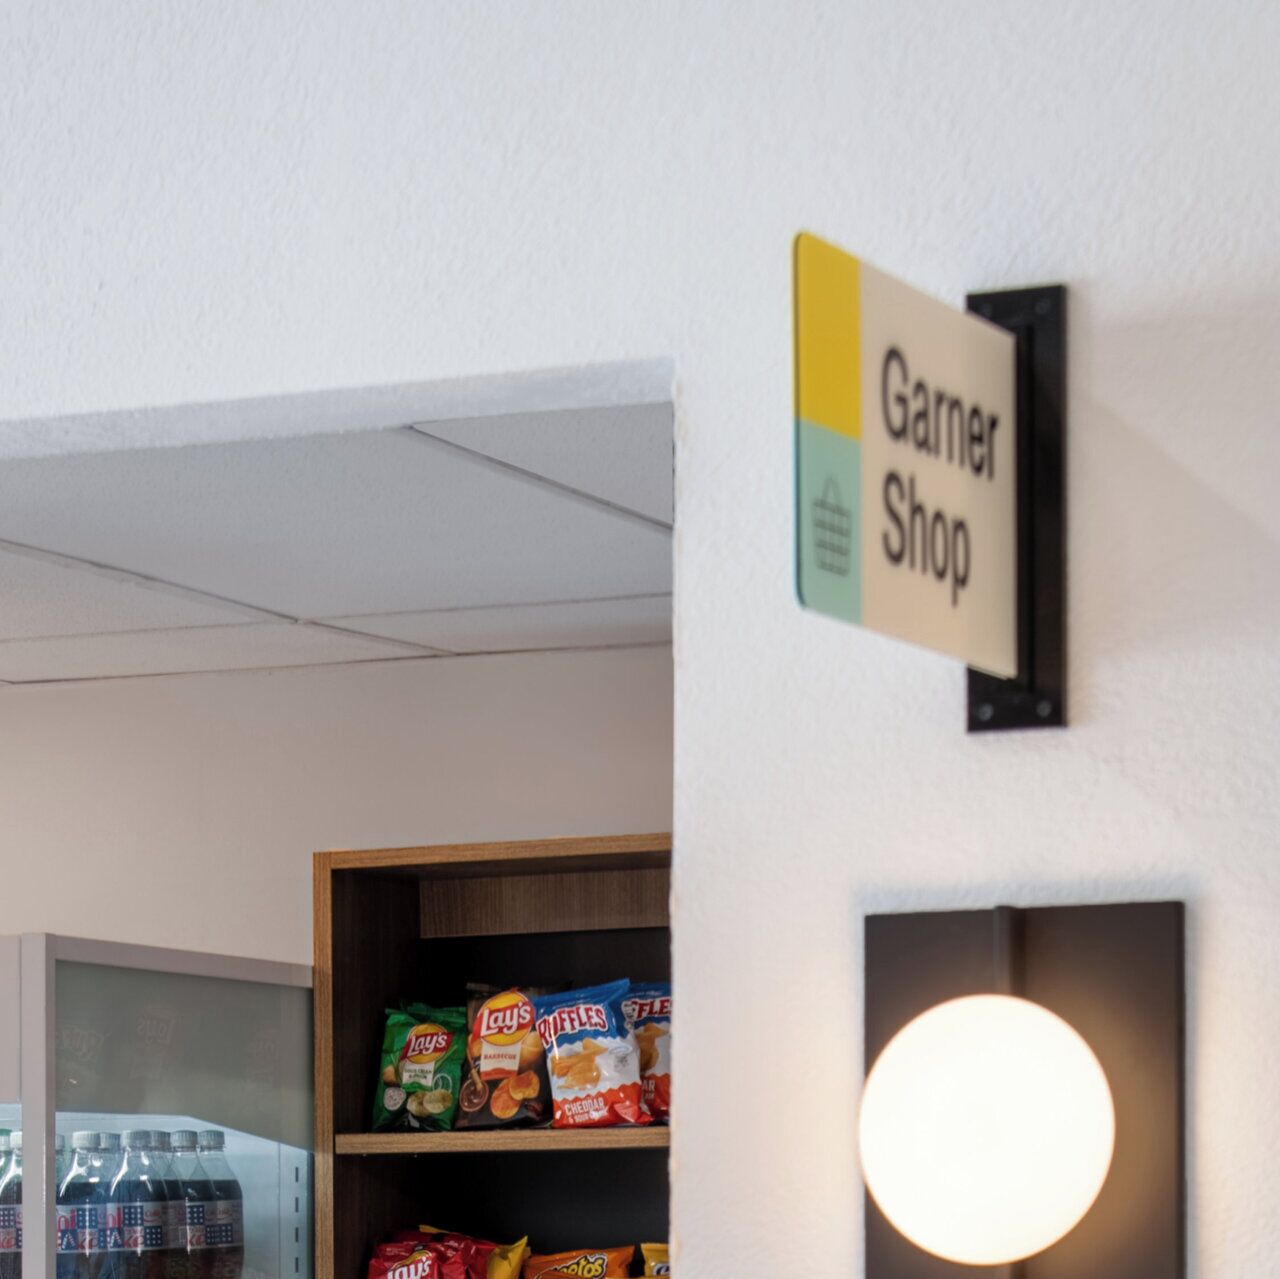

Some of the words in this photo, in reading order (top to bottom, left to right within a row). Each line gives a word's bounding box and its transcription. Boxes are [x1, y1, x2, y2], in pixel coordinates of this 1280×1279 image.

[881, 344, 1000, 481] Garner
[881, 472, 972, 608] Shop
[481, 1002, 532, 1036] Lay's
[537, 1005, 608, 1047] RUFFLES
[407, 1032, 448, 1057] Lay's
[565, 1099, 604, 1115] CHEDDAR
